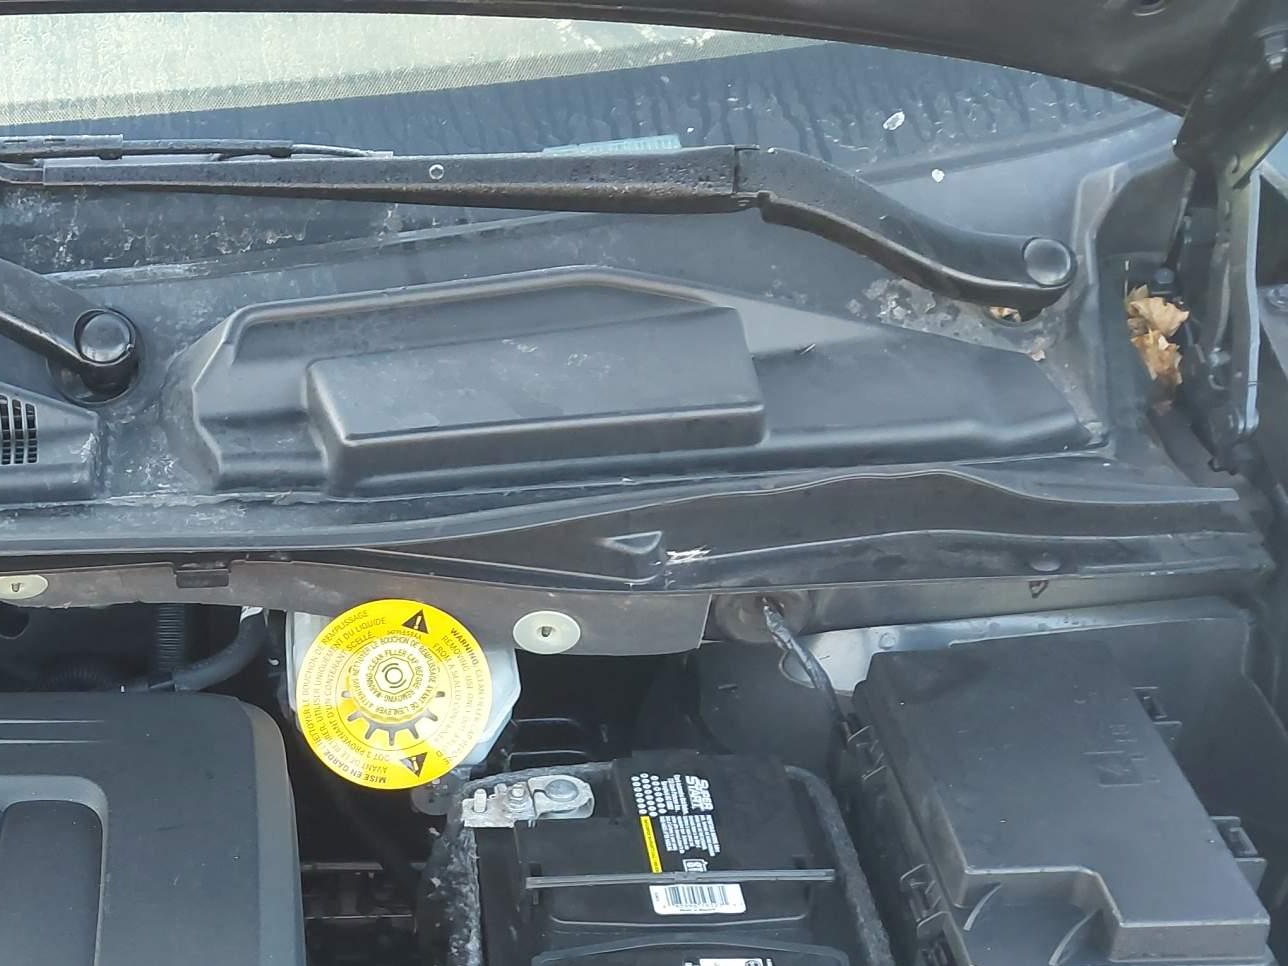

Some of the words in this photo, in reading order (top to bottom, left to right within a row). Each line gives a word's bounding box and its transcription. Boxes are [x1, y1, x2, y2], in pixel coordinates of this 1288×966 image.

[353, 616, 386, 634] LIQUIDE
[349, 767, 362, 779] EN
[362, 772, 386, 785] MISE
